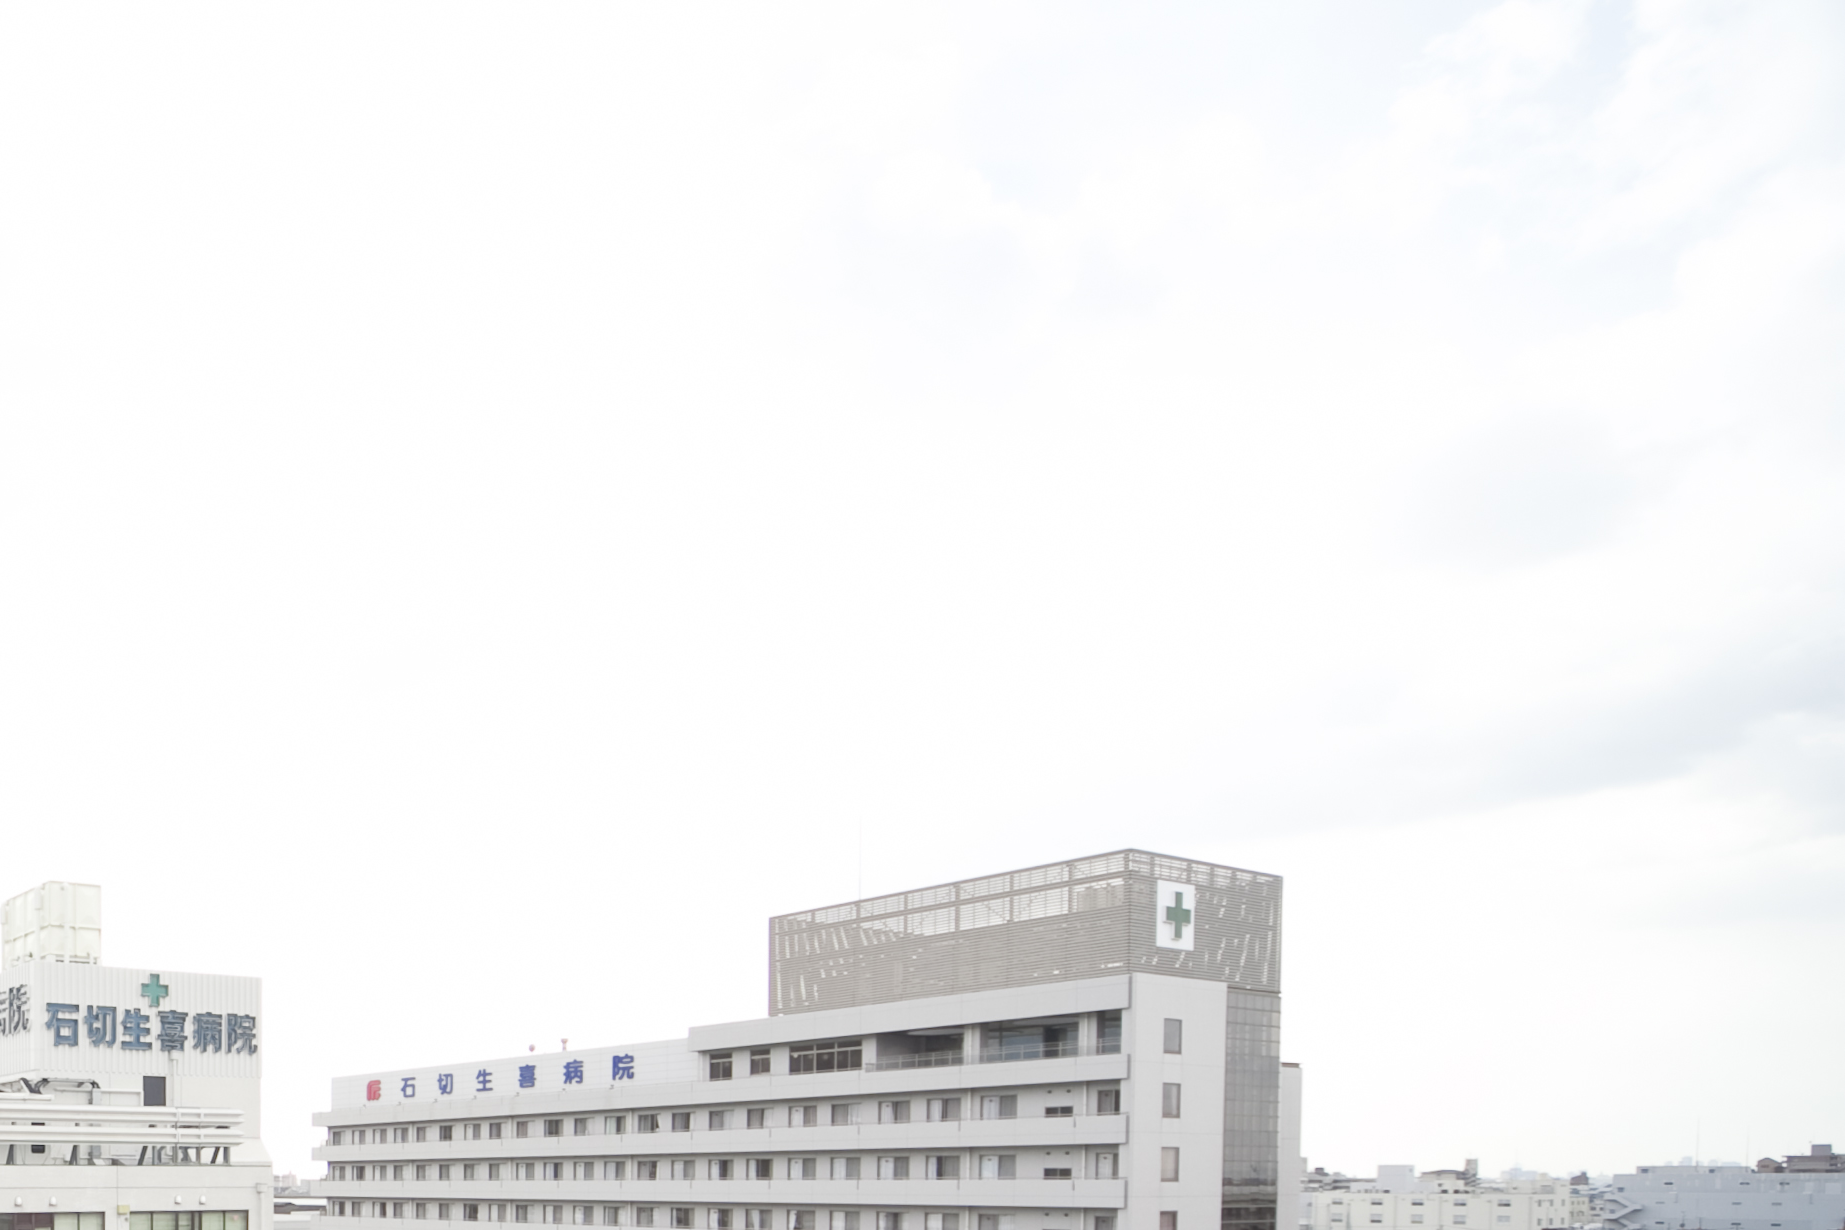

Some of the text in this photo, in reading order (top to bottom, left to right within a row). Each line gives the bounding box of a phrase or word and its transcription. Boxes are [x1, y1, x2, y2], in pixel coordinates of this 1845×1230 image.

[45, 1002, 258, 1056] 石切生喜病院
[400, 1053, 635, 1099] 石切生喜病院
